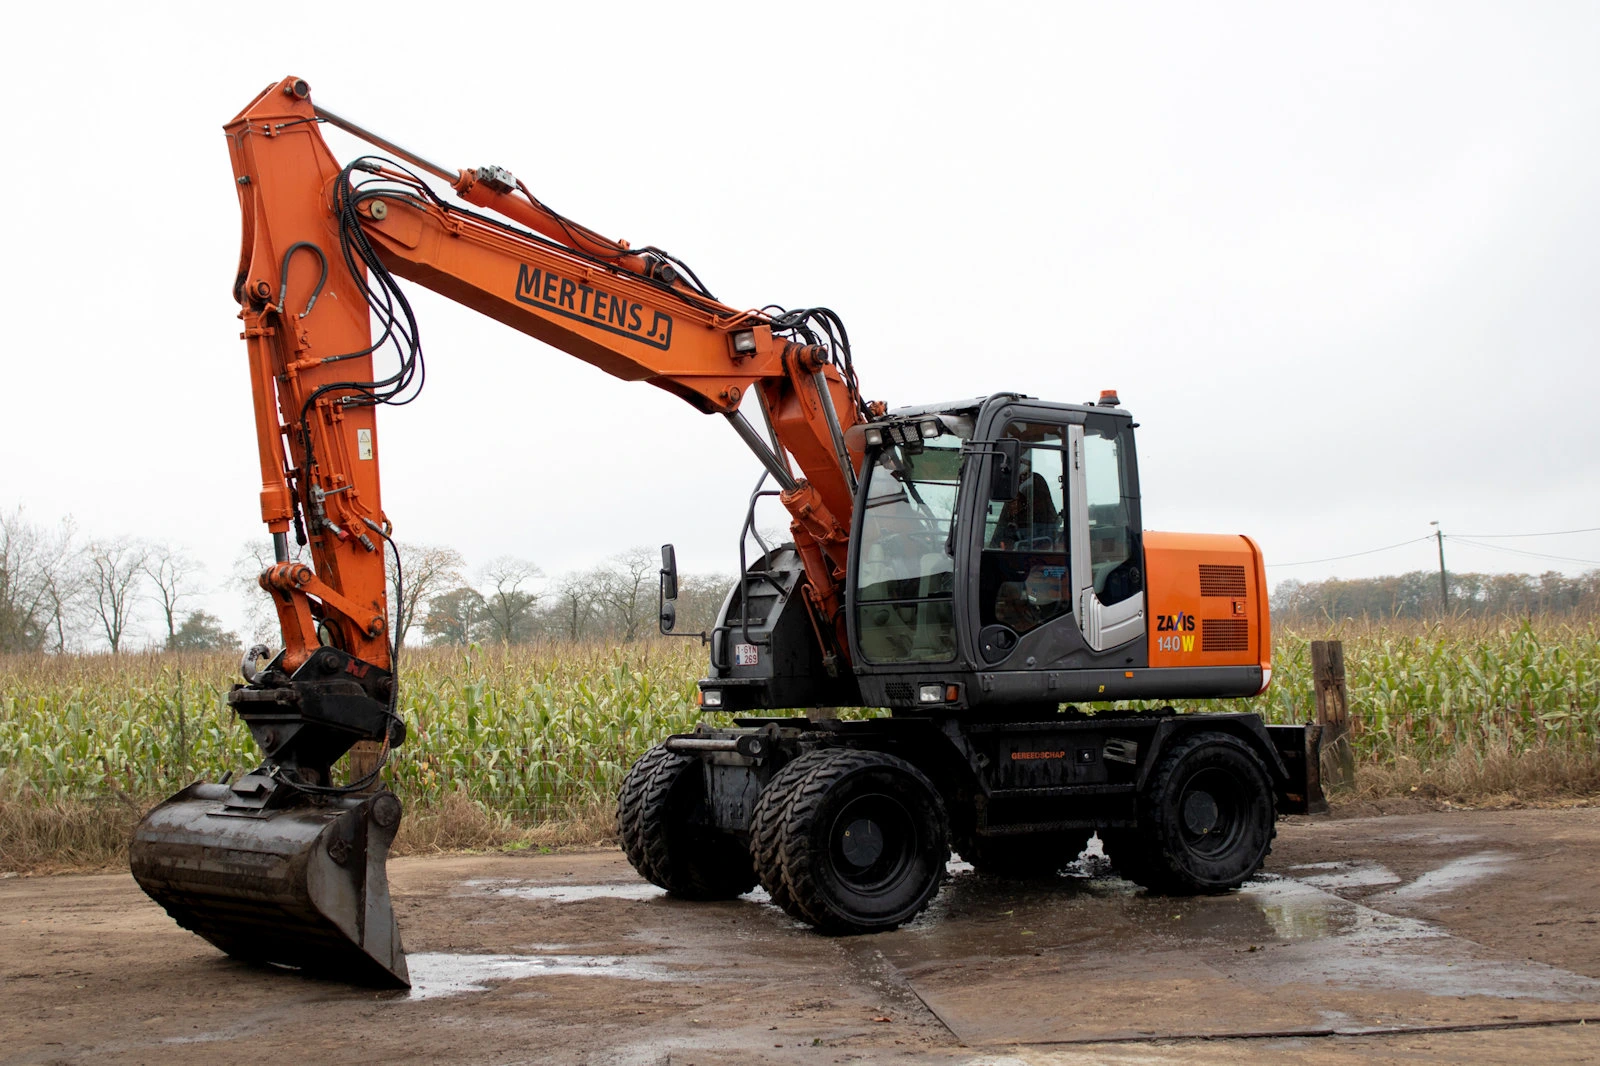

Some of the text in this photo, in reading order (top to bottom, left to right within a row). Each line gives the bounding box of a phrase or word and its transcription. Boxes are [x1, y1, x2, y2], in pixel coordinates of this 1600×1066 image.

[515, 263, 643, 331] MERTENS
[1157, 611, 1195, 631] ZAXIS
[744, 654, 757, 664] 269
[1011, 751, 1065, 760] GEREEDSCHAP
